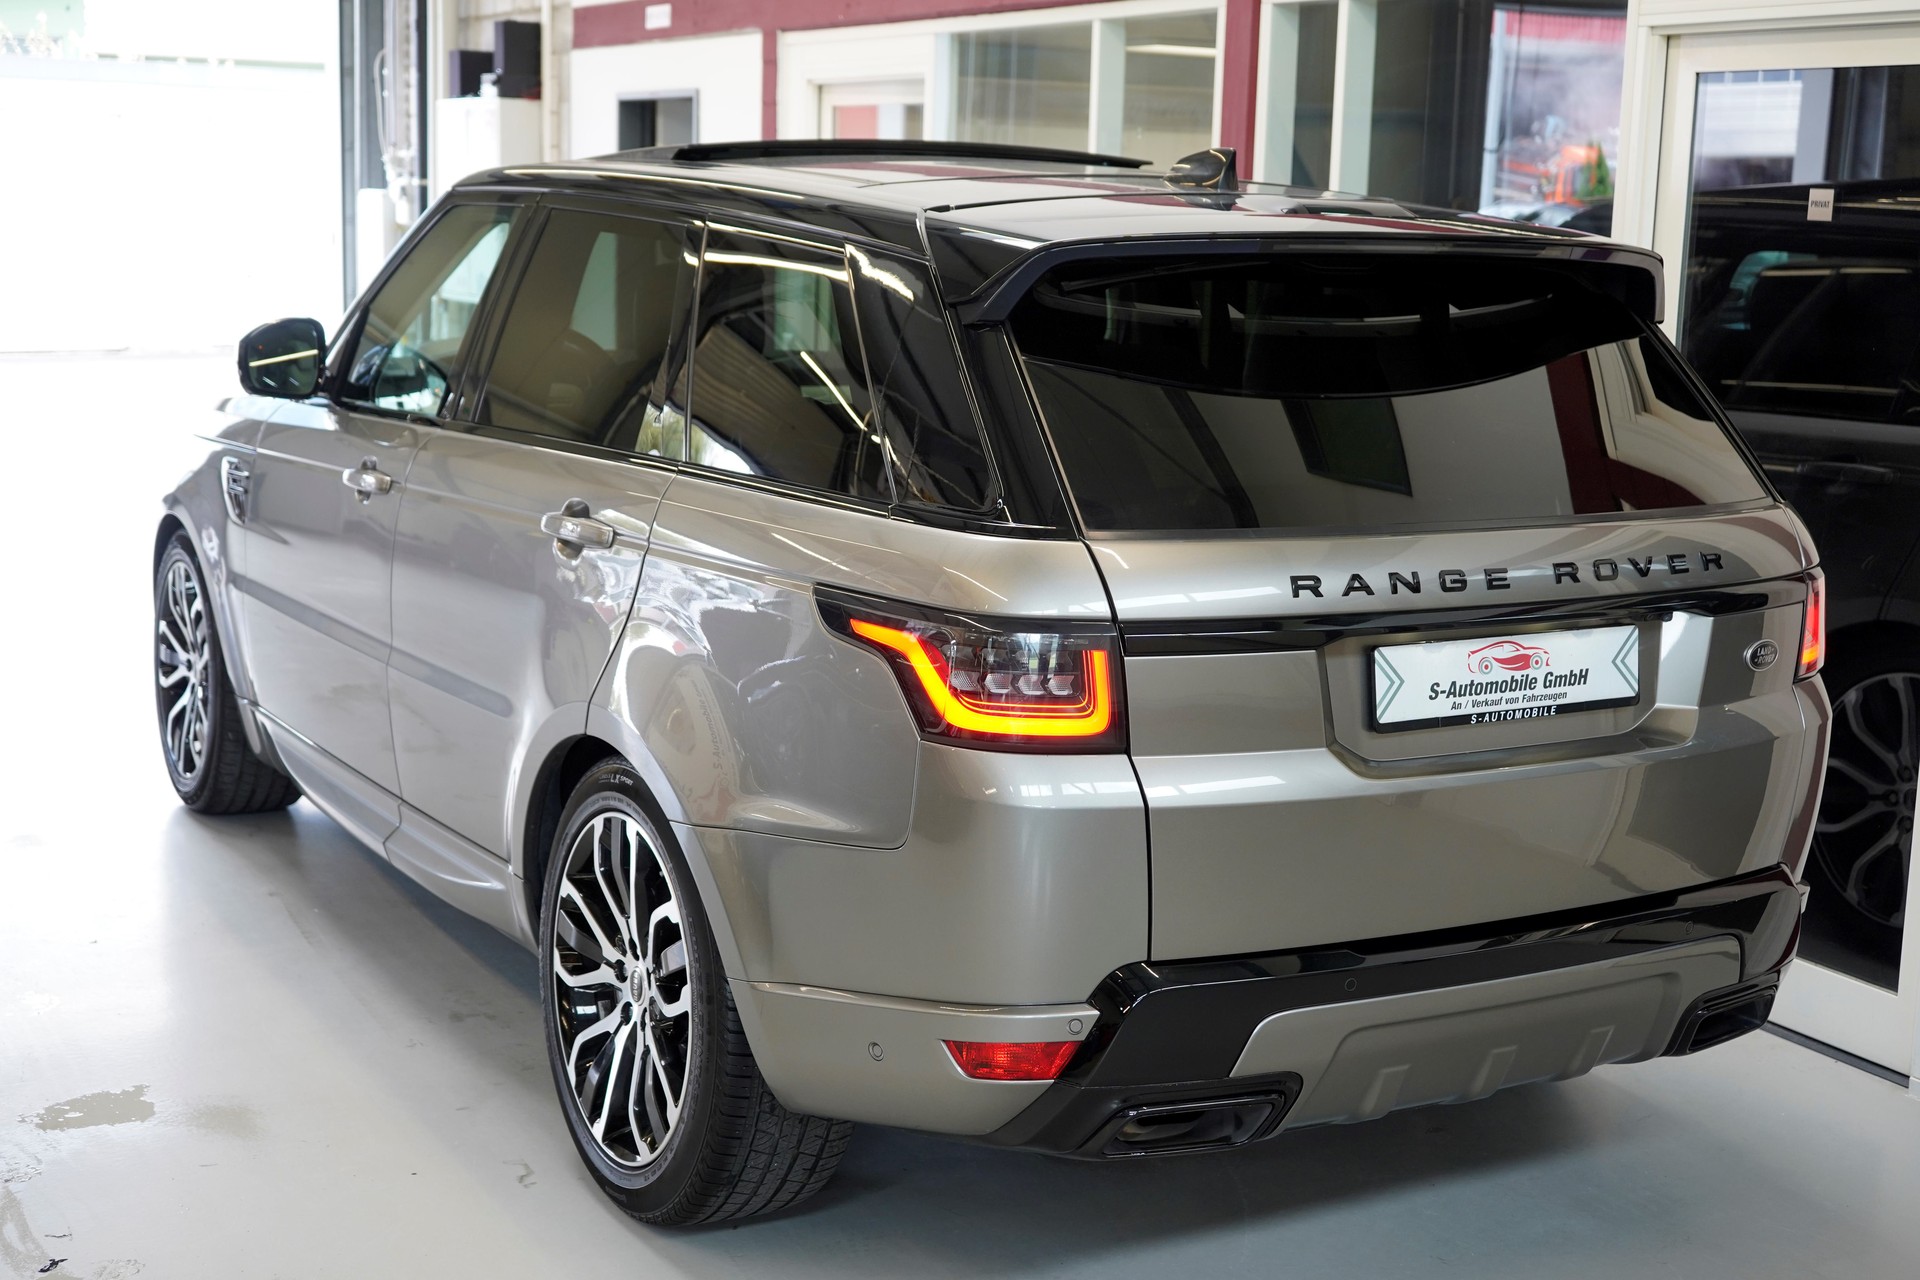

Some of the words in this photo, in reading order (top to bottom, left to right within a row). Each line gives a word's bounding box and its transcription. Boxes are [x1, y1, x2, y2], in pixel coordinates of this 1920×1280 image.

[1810, 200, 1830, 208] PRIVAT
[1289, 567, 1511, 598] RANGE
[1552, 551, 1723, 584] ROVER
[1428, 674, 1538, 701] S-Automobile
[1543, 668, 1590, 690] GmbH
[1450, 701, 1462, 711] An
[1464, 700, 1470, 709] /
[1471, 696, 1504, 709] Verkauf
[1505, 696, 1520, 705] von
[1522, 691, 1568, 703] Fahrzeugen
[1470, 705, 1557, 724] S-AUTOMOBILE
